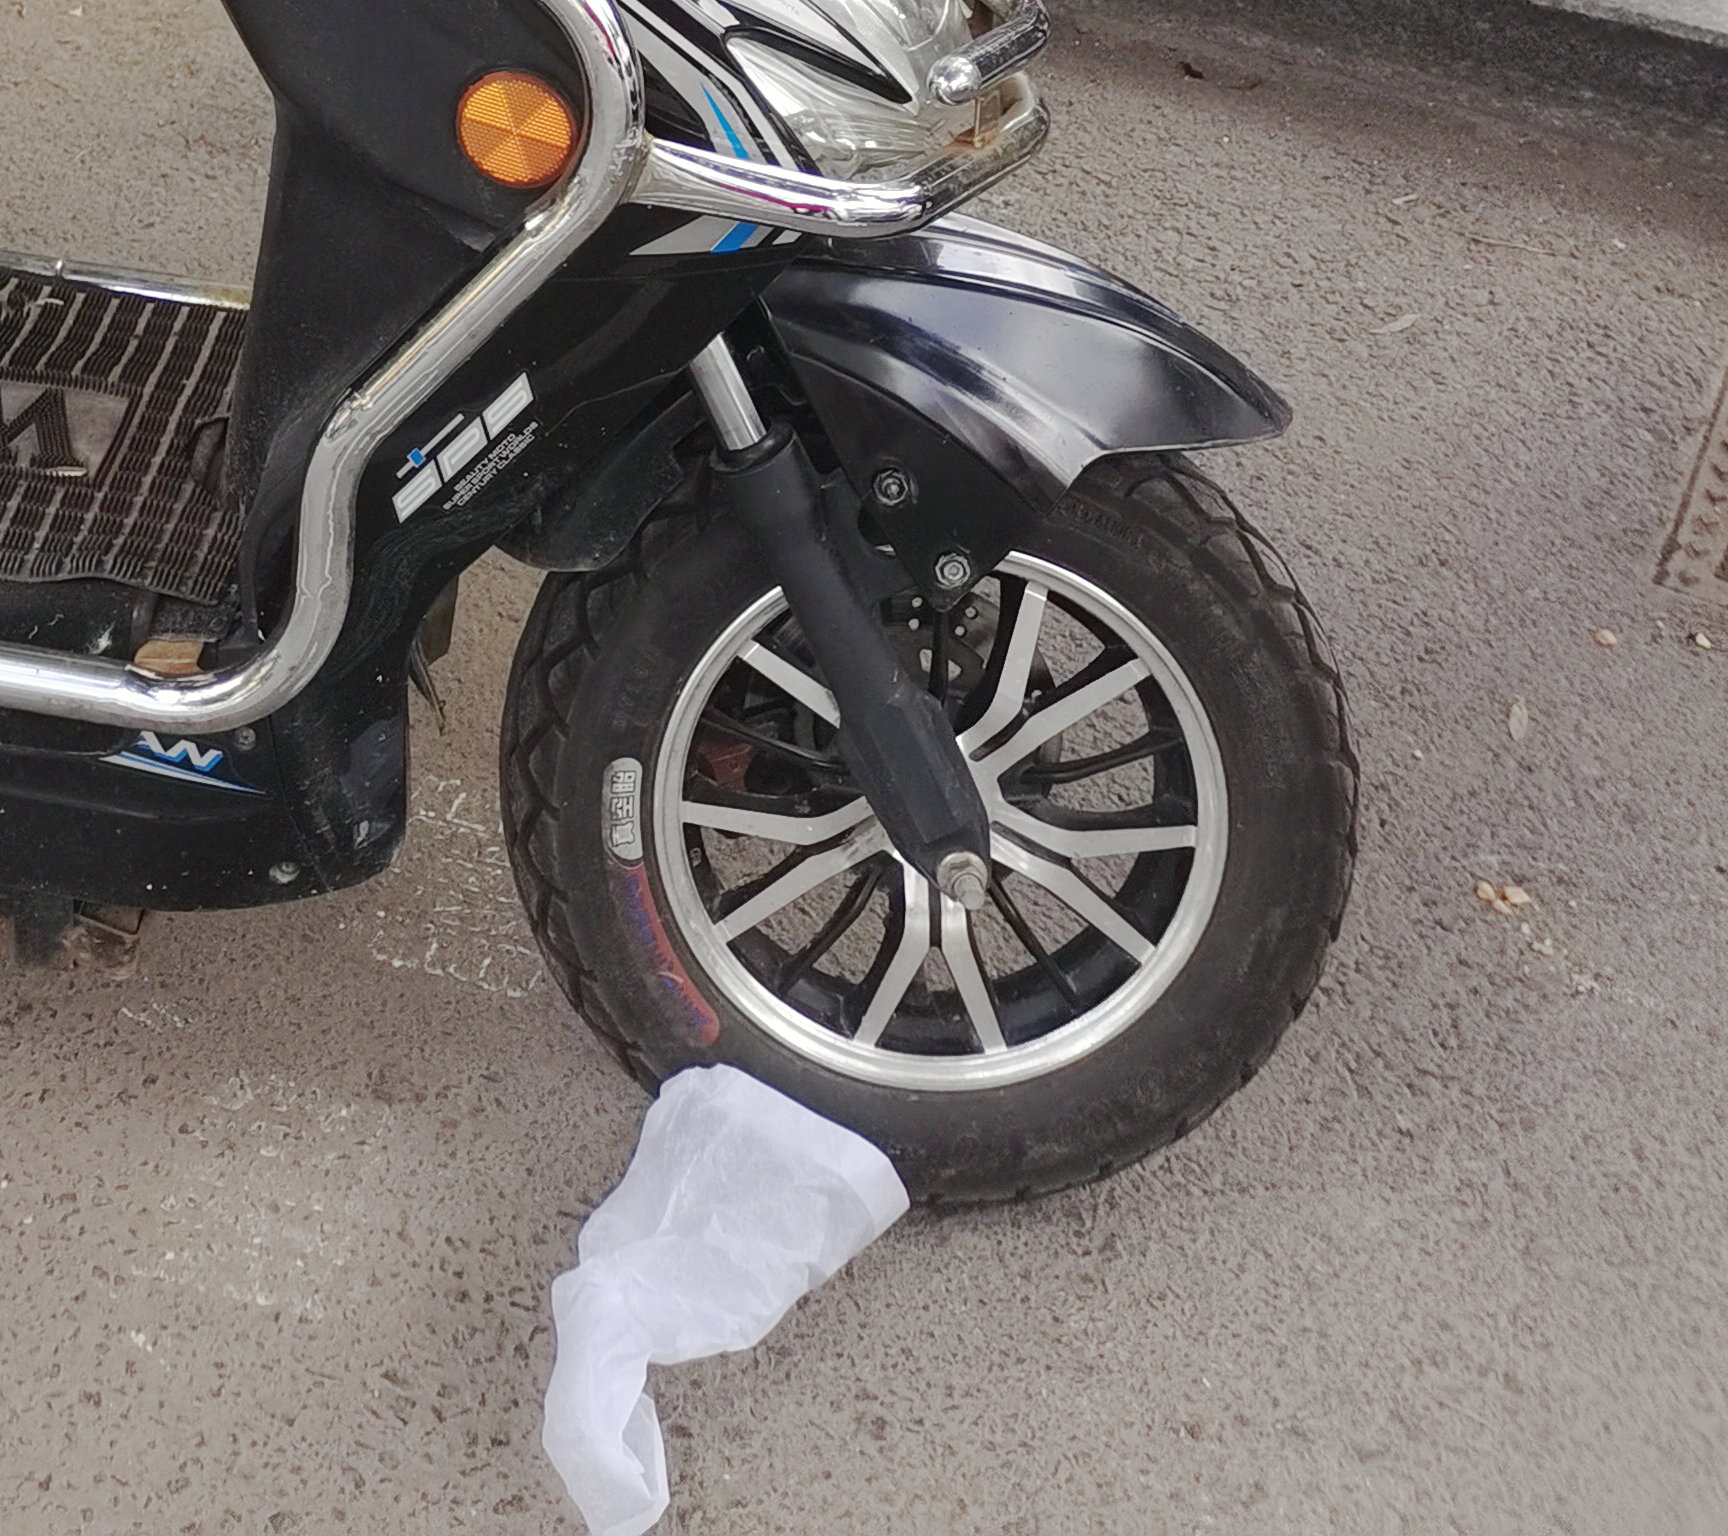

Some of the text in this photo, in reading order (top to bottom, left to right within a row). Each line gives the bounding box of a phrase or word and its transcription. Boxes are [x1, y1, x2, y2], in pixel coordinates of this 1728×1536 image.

[441, 481, 473, 511] SUPER
[470, 455, 502, 485] SPORT
[452, 432, 516, 492] BEAUTY MOTO
[456, 432, 535, 507] CENTURY CLASSIC
